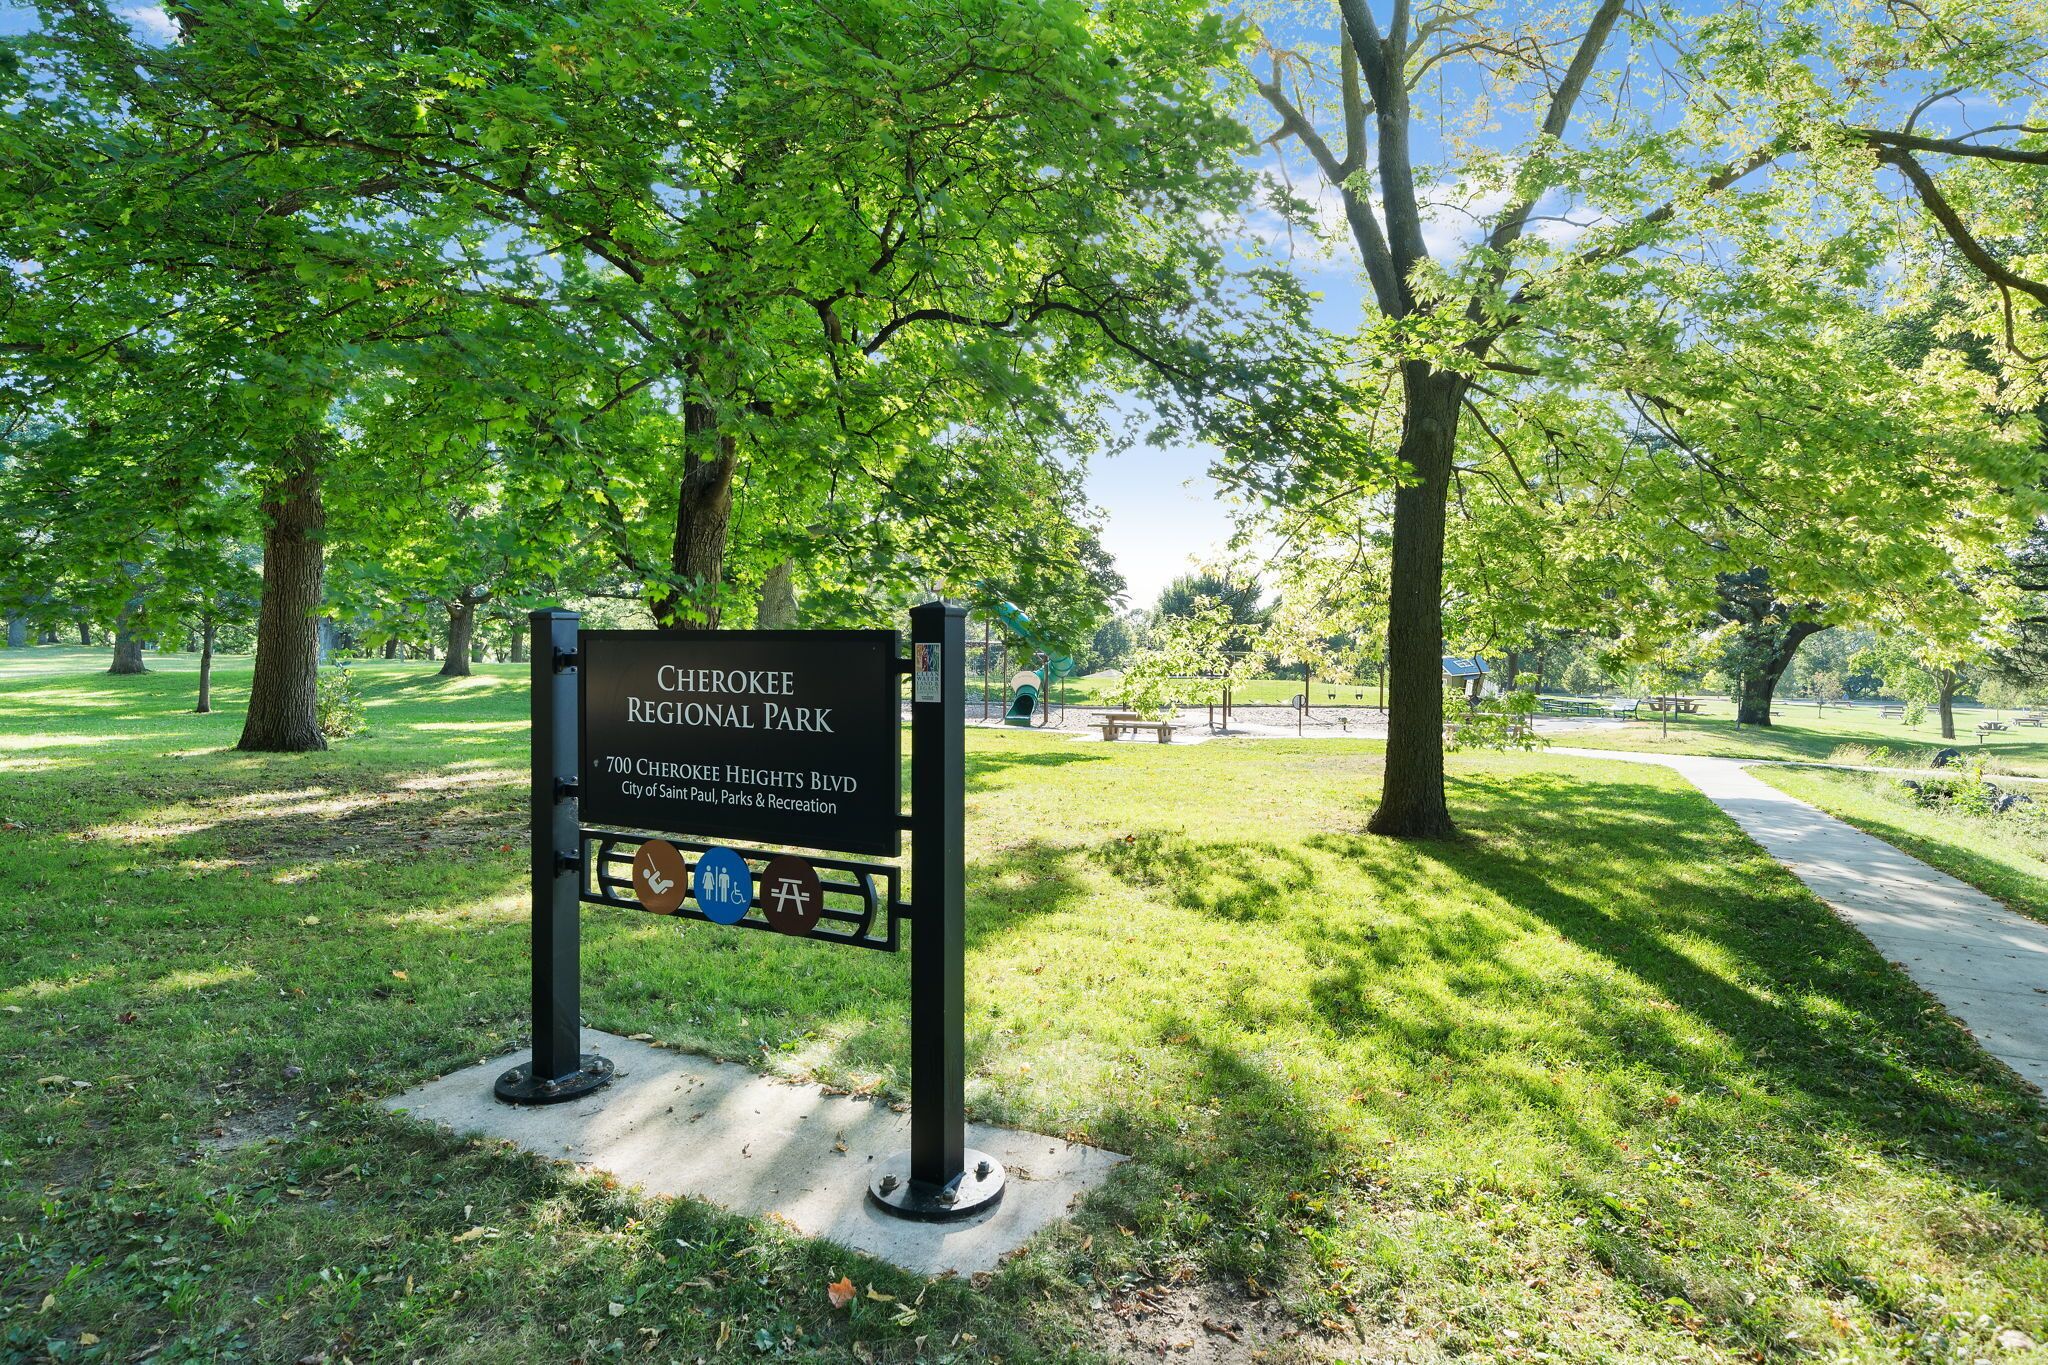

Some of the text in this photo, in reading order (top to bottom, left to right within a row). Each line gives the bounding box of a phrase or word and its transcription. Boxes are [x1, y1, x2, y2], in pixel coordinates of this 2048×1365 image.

[606, 755, 632, 775] 700
[621, 780, 837, 815] City of Saint Paul, Parks & Recreation
